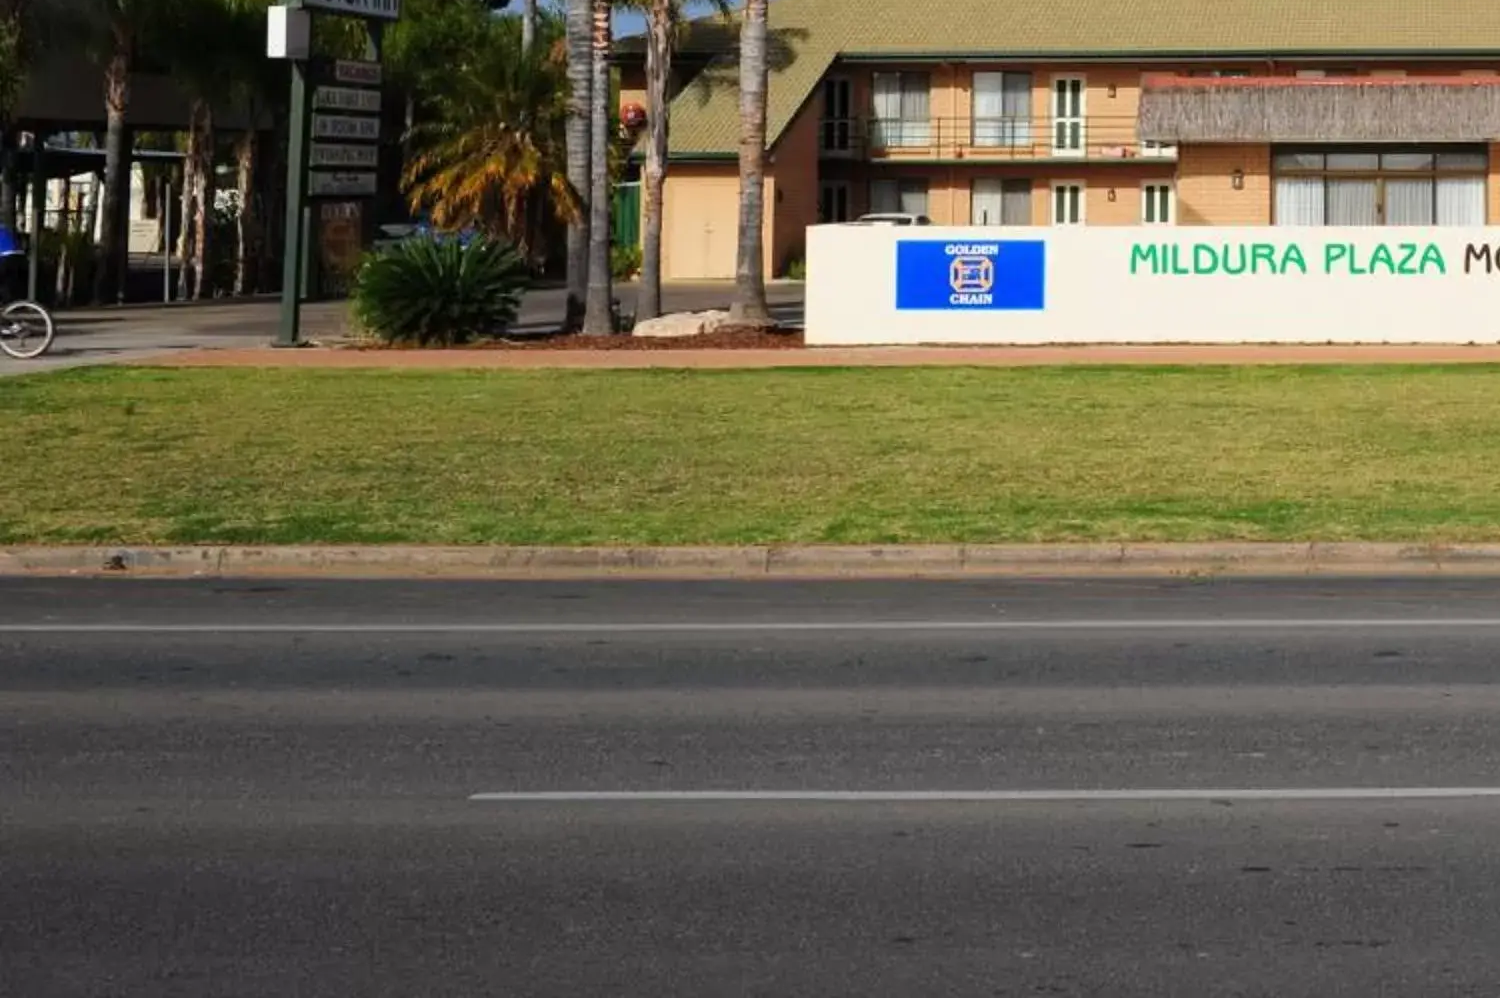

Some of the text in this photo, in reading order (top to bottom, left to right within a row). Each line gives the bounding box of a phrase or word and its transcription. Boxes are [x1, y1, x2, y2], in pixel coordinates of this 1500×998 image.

[945, 243, 999, 255] GOLDEN
[1130, 243, 1307, 275] MILDURA
[1324, 243, 1446, 275] PLAZA
[949, 293, 993, 305] CHAIN
